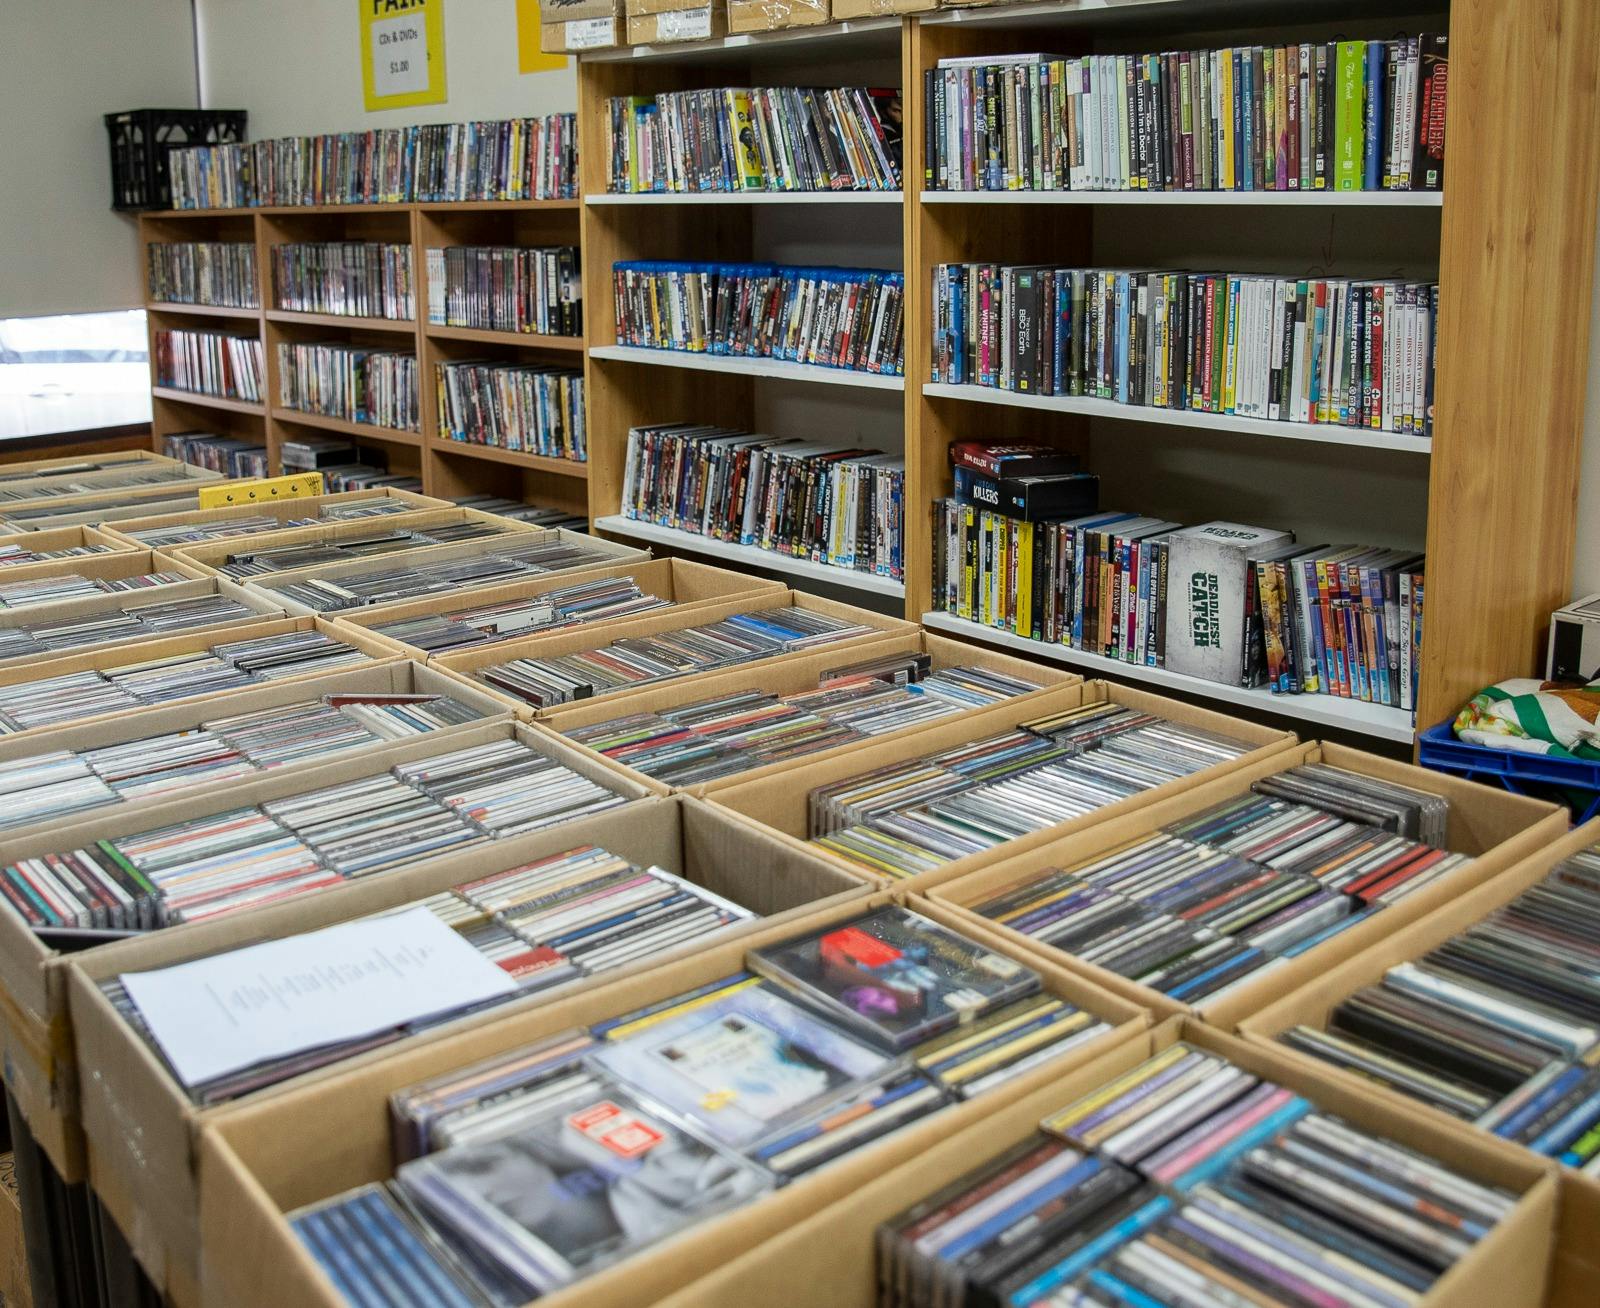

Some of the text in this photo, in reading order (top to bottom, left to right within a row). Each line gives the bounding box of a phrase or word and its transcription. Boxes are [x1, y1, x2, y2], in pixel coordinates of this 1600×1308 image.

[390, 60, 410, 74] $1.00
[1136, 79, 1144, 96] Trust
[1137, 98, 1144, 112] me
[1428, 63, 1448, 147] GODFATHER
[1403, 92, 1413, 150] HISTORY WWII
[1139, 134, 1147, 161] Doctor
[1393, 132, 1401, 152] WWII
[981, 309, 989, 346] WHITNEY
[1351, 301, 1359, 340] DEADLIEST
[1364, 301, 1372, 340] DEADLIEST
[1018, 331, 1026, 355] Earth
[1364, 340, 1372, 364] CATCH
[1405, 337, 1413, 367] HISTORY
[1416, 341, 1424, 371] HISTORY
[973, 484, 999, 505] KILLERS
[821, 515, 831, 542] LEGACY
[1150, 562, 1158, 579] WIDE
[1149, 595, 1157, 613] ROAD
[1191, 572, 1210, 647] CATCH
[1208, 574, 1221, 648] DEADLIEST
[1294, 588, 1308, 659] GALLIPOLI SUBMARINE
[1402, 619, 1410, 636] The
[1401, 638, 1409, 655] Sky
[1401, 668, 1409, 689] Gray
